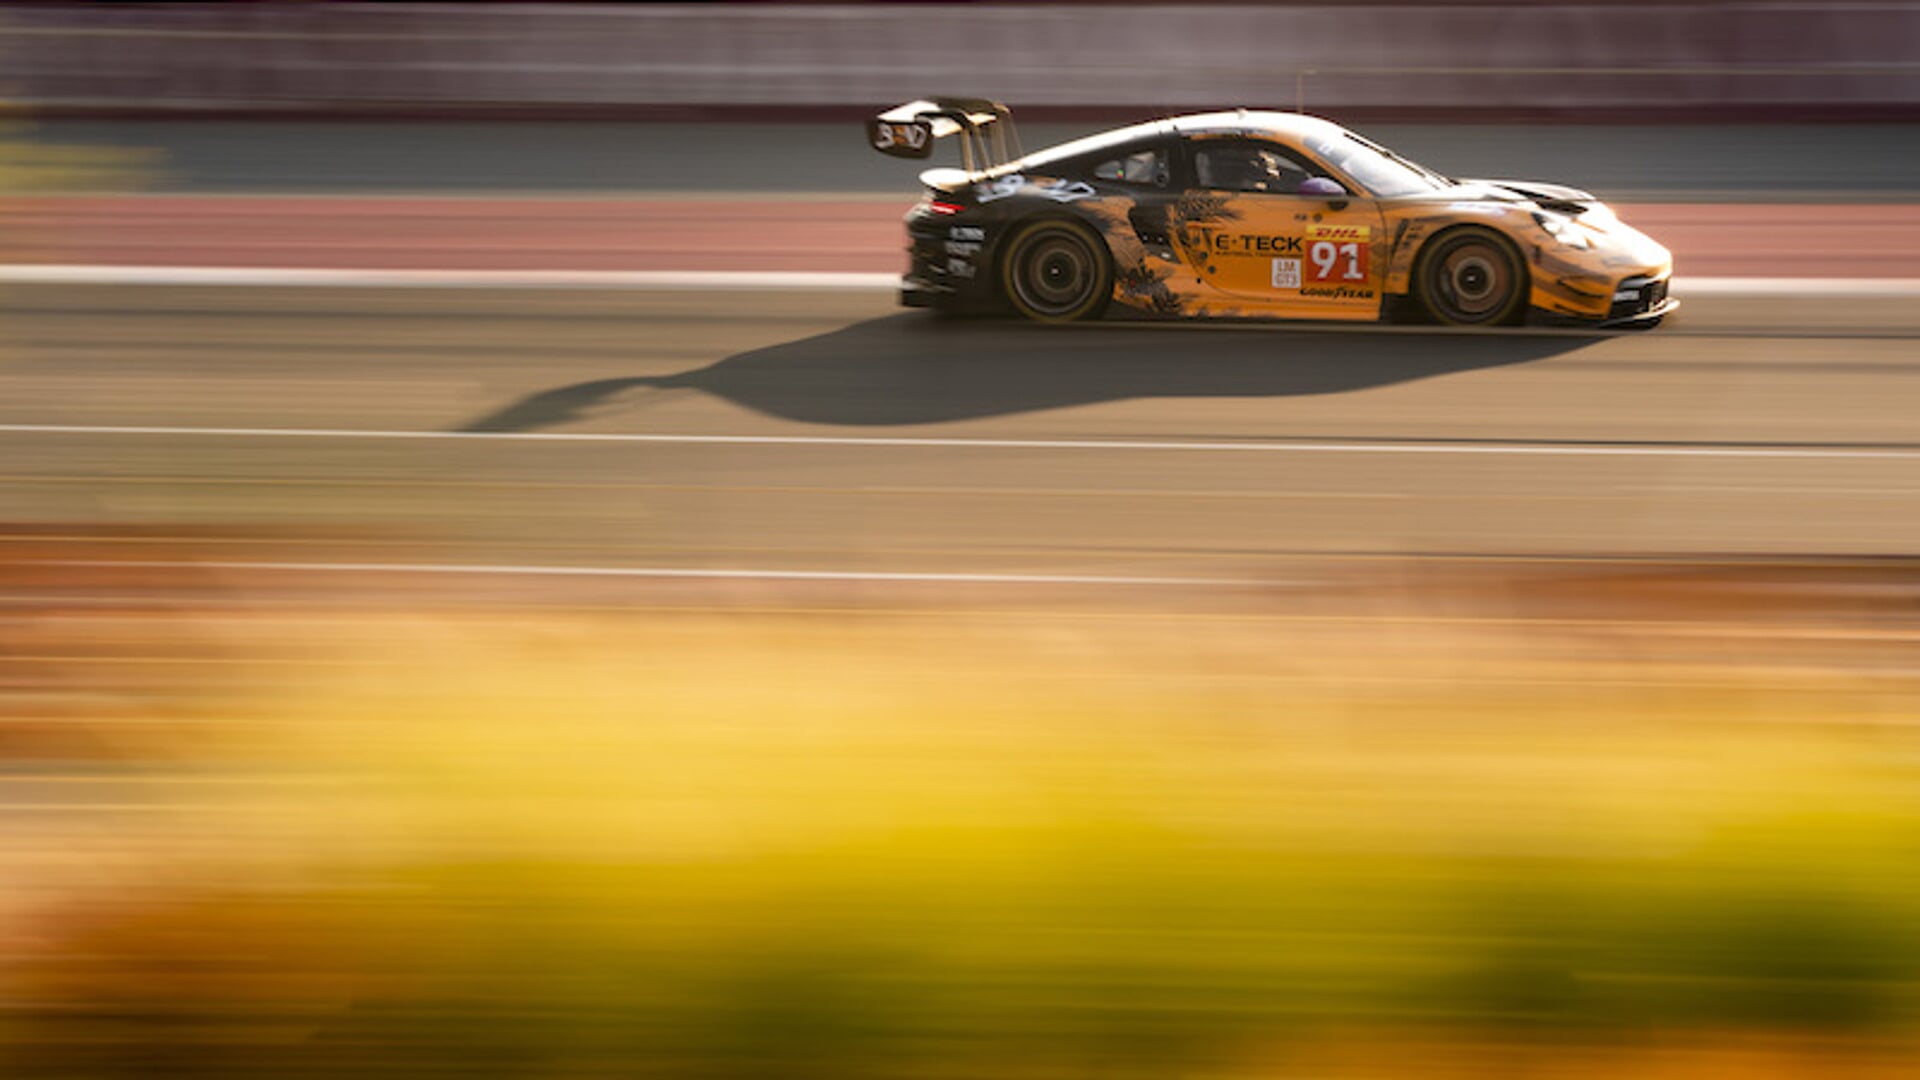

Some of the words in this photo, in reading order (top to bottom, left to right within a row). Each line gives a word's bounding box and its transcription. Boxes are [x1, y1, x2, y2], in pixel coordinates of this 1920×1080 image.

[1317, 228, 1360, 238] DHL
[1311, 241, 1363, 279] 91
[1277, 261, 1295, 272] LM
[1300, 287, 1373, 299] GOODYEAR
